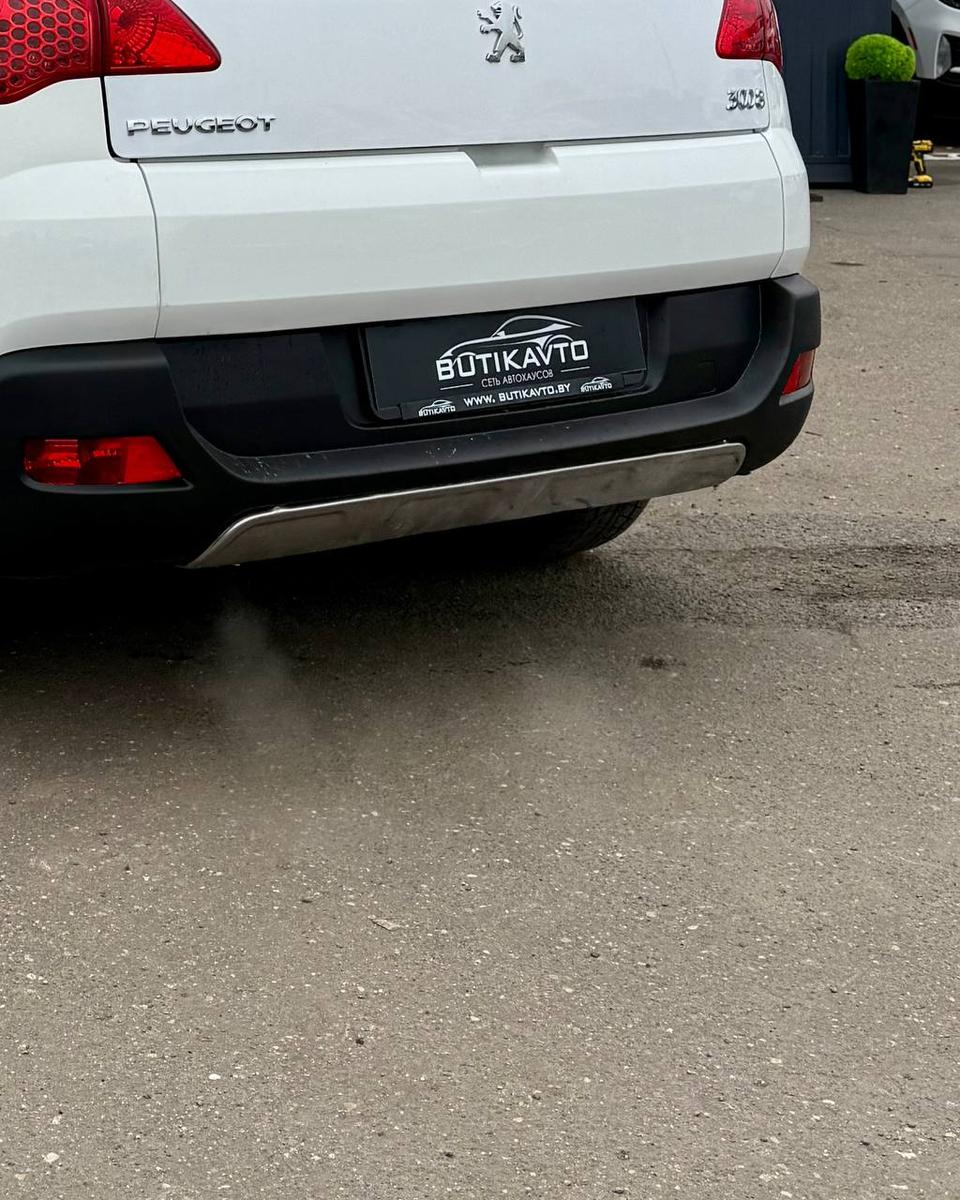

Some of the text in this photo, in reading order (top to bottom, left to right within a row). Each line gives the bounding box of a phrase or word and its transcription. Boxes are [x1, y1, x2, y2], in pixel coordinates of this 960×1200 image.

[126, 114, 277, 136] PEUGEOT
[435, 339, 589, 381] BUTIKAVTO
[481, 368, 554, 388] СЕТЬ АВТОХАУСОВ
[580, 382, 613, 393] BUTIKAVTO
[463, 383, 571, 407] WWW. BUTIKAVTO.BY
[418, 405, 456, 417] BUTIKAVTO
